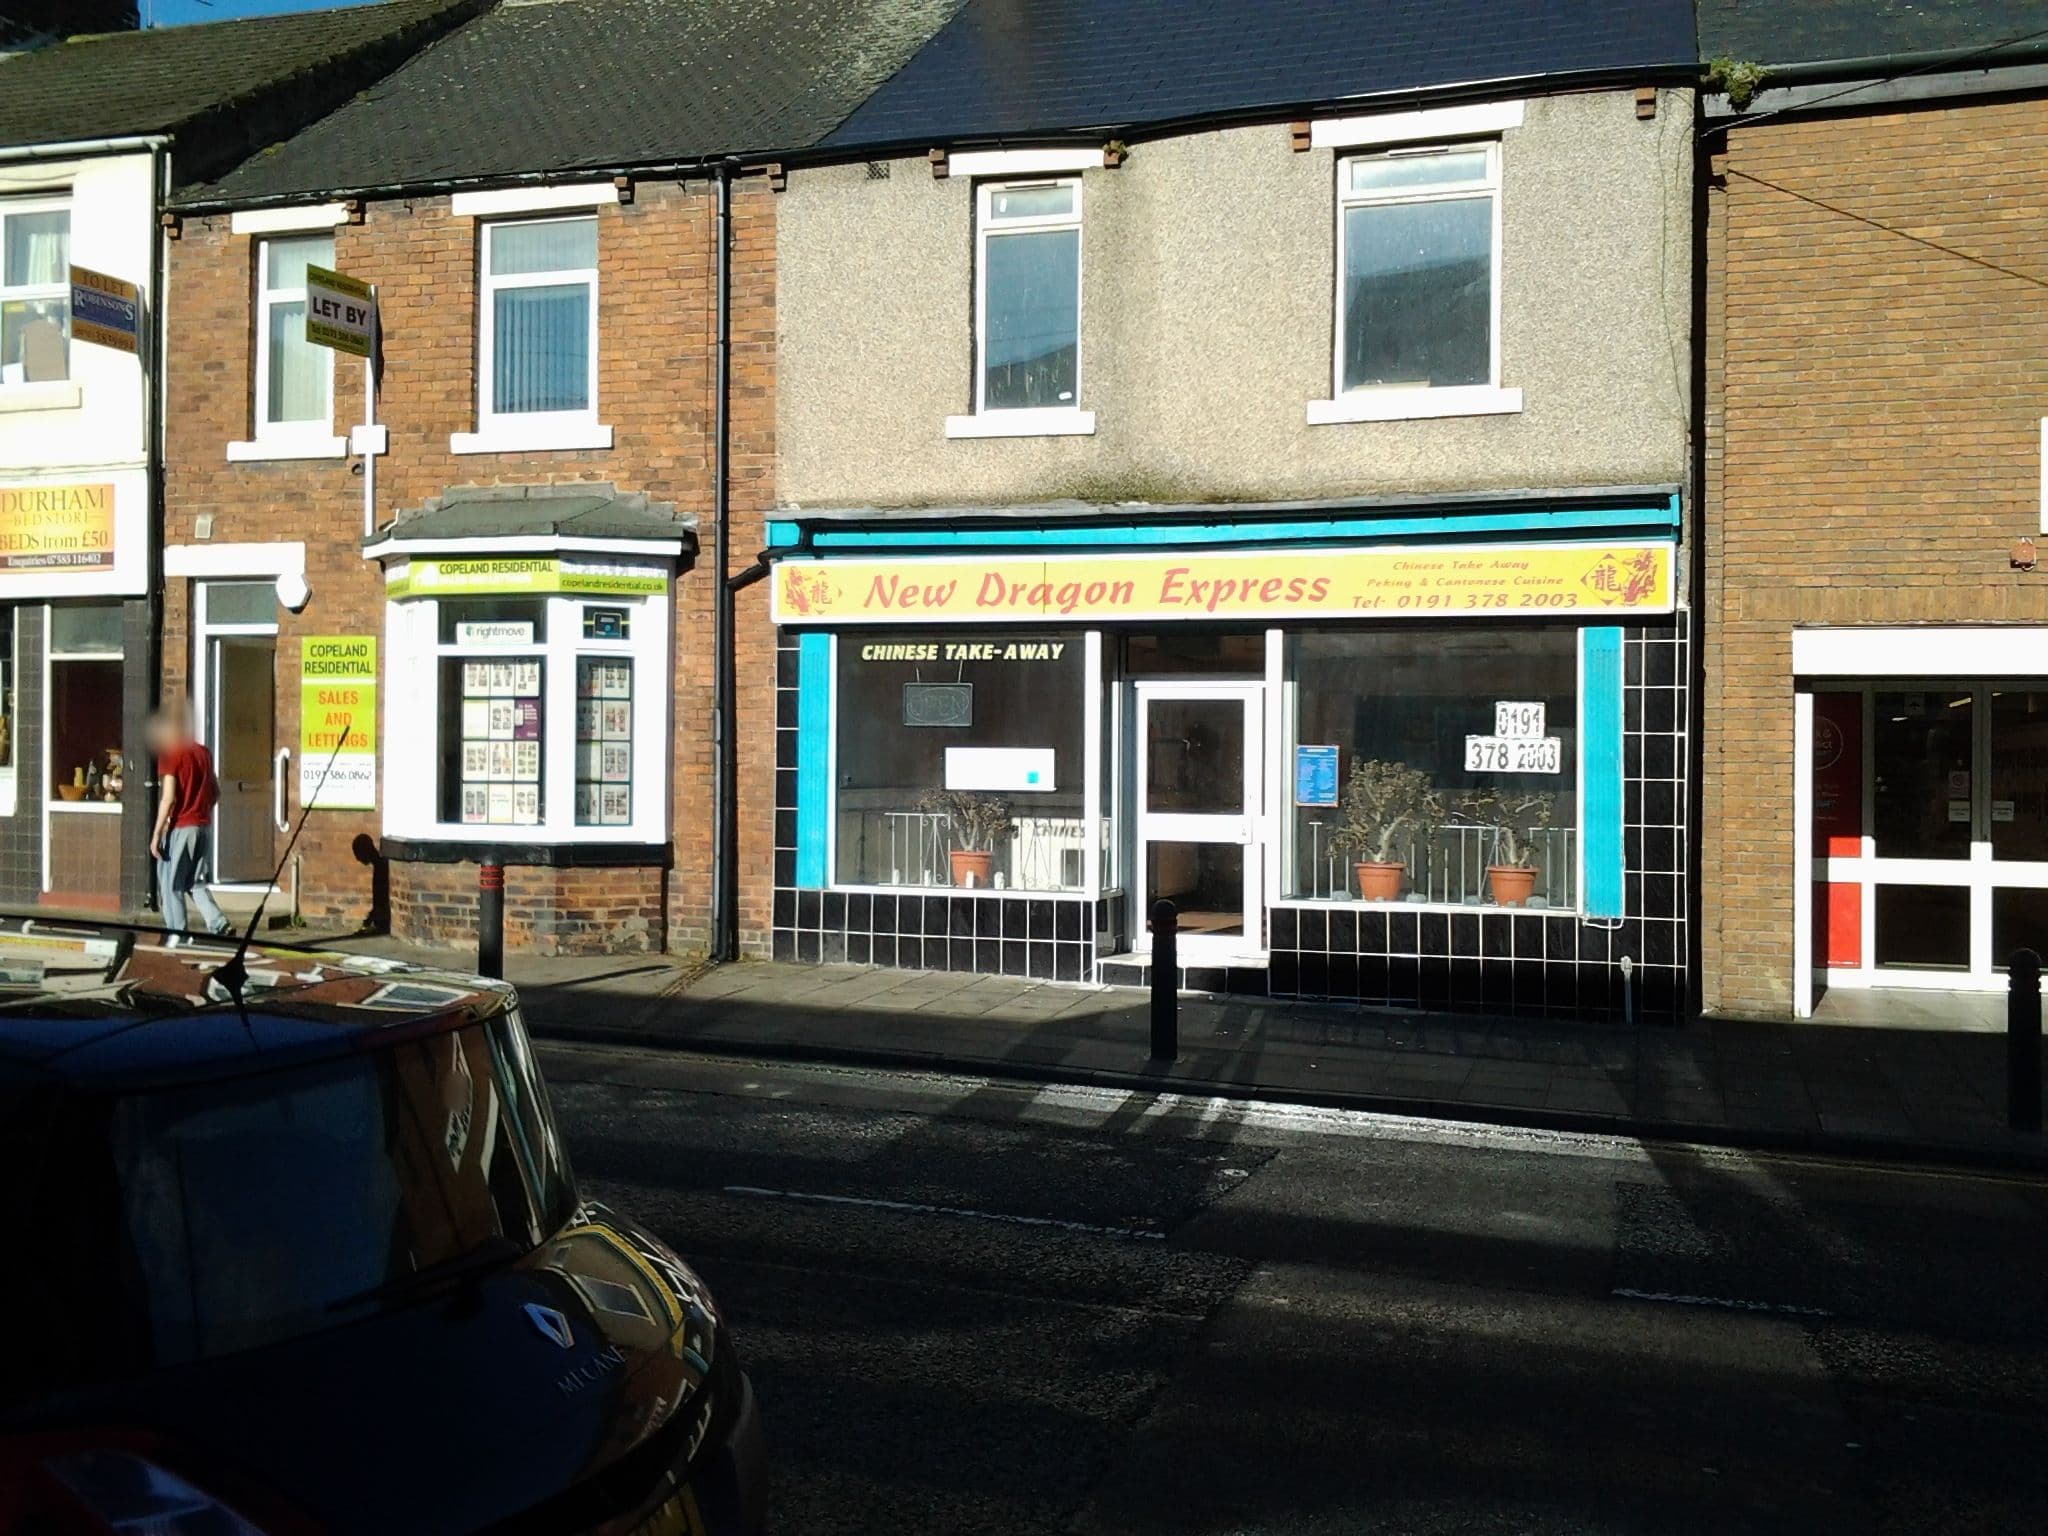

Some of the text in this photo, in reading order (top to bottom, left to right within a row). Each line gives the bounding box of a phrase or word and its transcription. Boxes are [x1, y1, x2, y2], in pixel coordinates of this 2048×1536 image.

[73, 287, 134, 321] ROBINSONS
[312, 295, 367, 326] LET BY
[1, 488, 104, 512] DURHAM
[0, 530, 109, 550] BEDS from £50
[439, 562, 490, 575] COPELAND
[492, 561, 553, 574] RESIDENTIAL
[1392, 559, 1530, 571] Chinese Take Away
[561, 578, 663, 591] copelandresidential.co.uk
[1366, 575, 1564, 588] Peking & Cantonese Cuisine
[863, 567, 1331, 614] New Dragon Express
[1397, 594, 1453, 608] 0191
[1464, 594, 1508, 608] 378
[1519, 593, 1578, 608] 2003
[476, 625, 525, 639] rightmove
[310, 644, 368, 658] COPELAND
[861, 643, 1065, 660] CHINESE TAKE-AWAY
[304, 661, 373, 675] RESIDENTIAL
[318, 690, 359, 705] SALES
[325, 712, 353, 727] AND
[1498, 707, 1540, 736] 0191
[308, 732, 369, 747] LETTINGS
[1471, 742, 1556, 770] 378 2003
